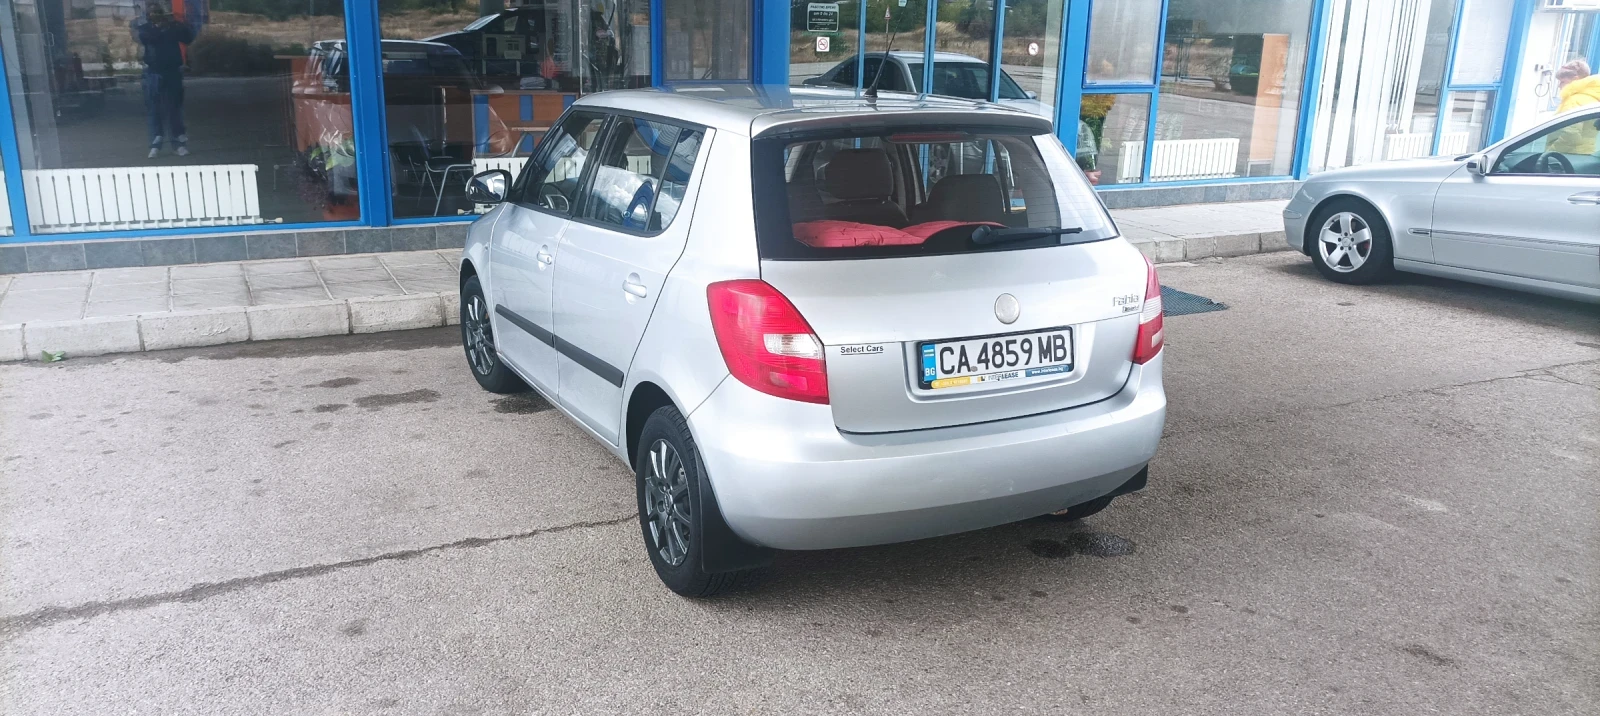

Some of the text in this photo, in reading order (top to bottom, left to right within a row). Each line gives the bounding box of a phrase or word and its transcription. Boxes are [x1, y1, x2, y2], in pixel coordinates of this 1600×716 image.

[939, 334, 1067, 374] CA 4859 MB
[925, 367, 935, 376] BG
